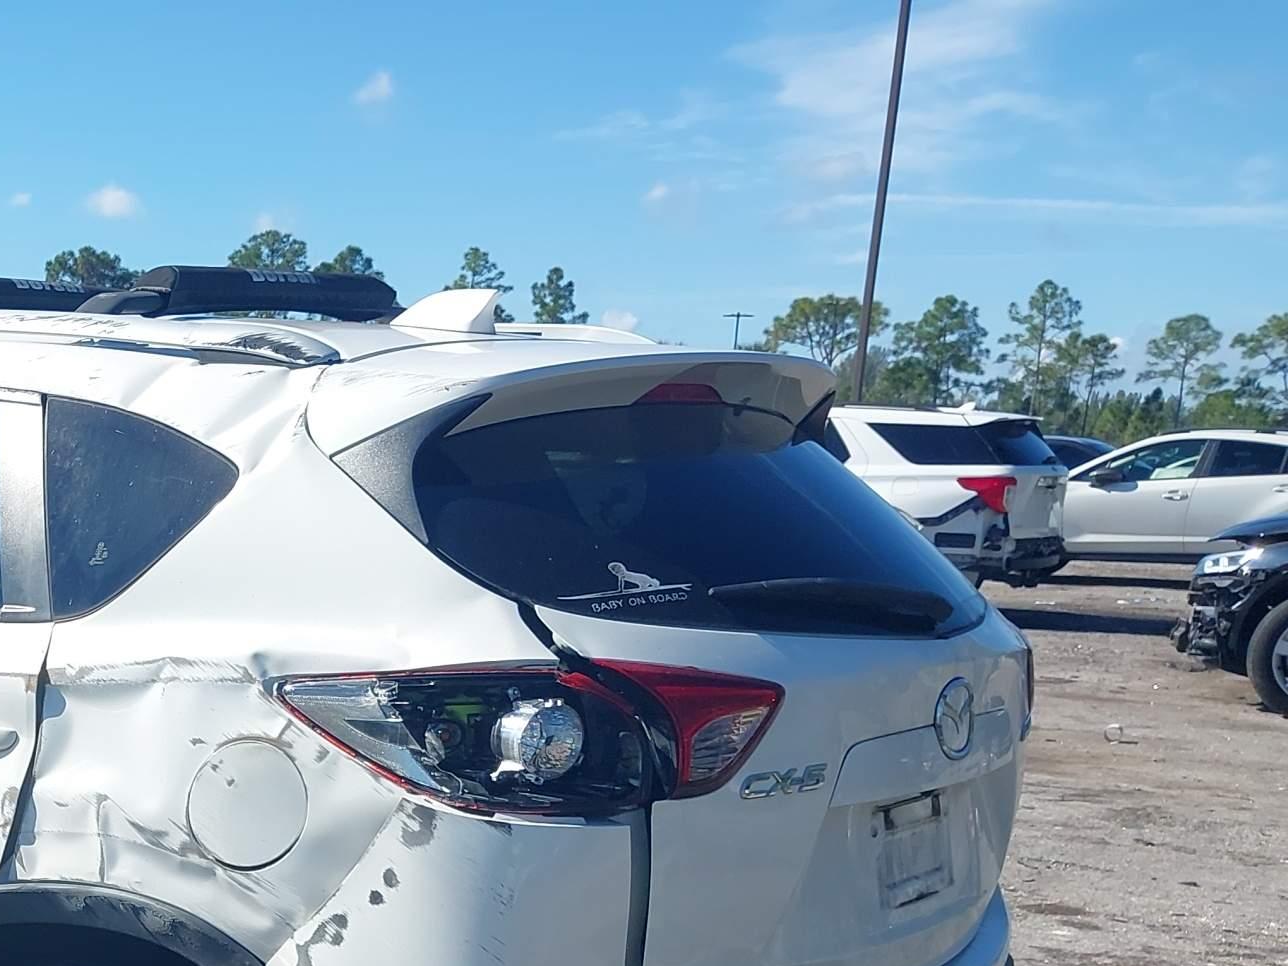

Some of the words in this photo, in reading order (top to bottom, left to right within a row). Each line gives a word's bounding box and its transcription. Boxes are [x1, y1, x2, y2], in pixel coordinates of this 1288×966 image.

[591, 599, 623, 613] BABY
[628, 597, 646, 608] ON
[648, 592, 688, 604] BOARD
[739, 763, 827, 800] CX-5
